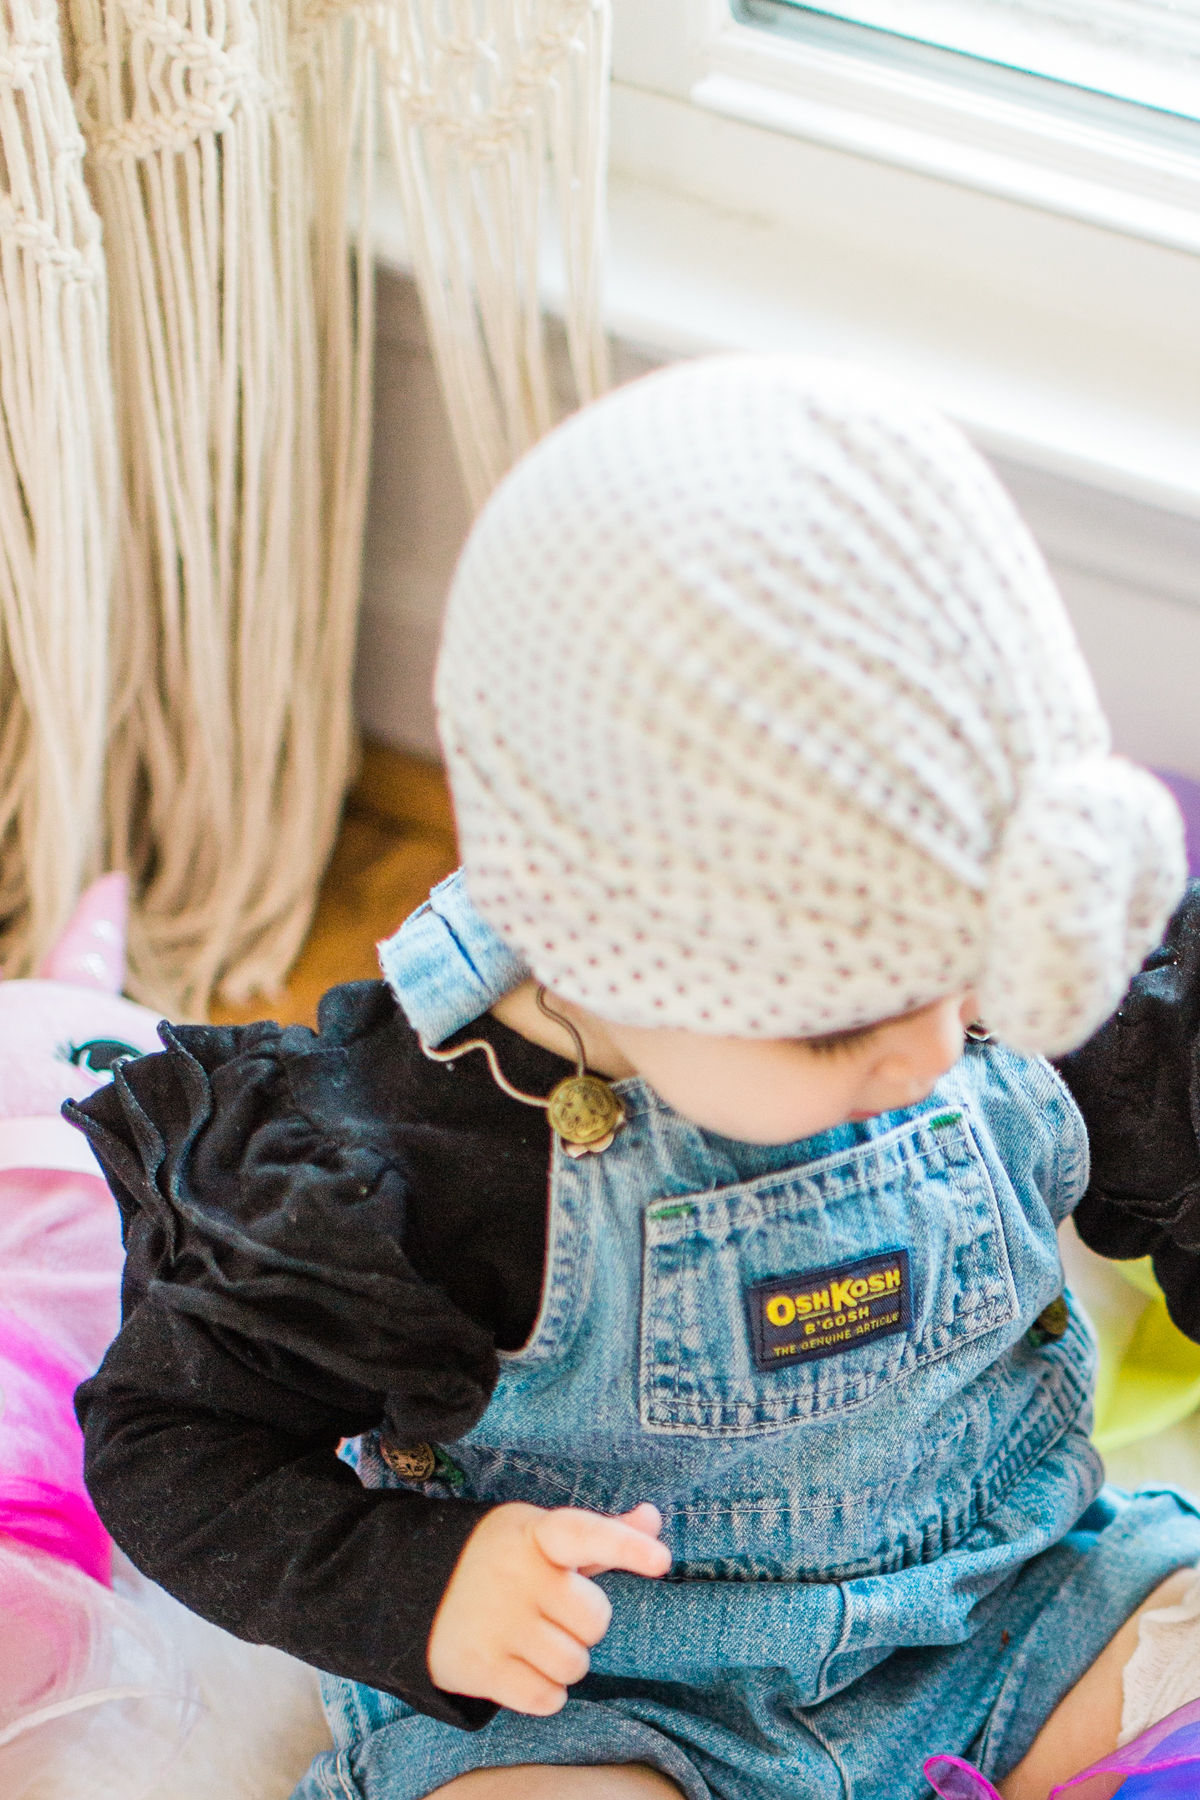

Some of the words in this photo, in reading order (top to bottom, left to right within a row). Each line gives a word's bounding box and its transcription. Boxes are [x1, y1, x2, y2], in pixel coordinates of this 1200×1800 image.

[773, 1346, 797, 1357] THE
[801, 1331, 852, 1351] GENUINE
[856, 1312, 899, 1335] ARTICLE
[804, 1306, 870, 1335] B'GOSH
